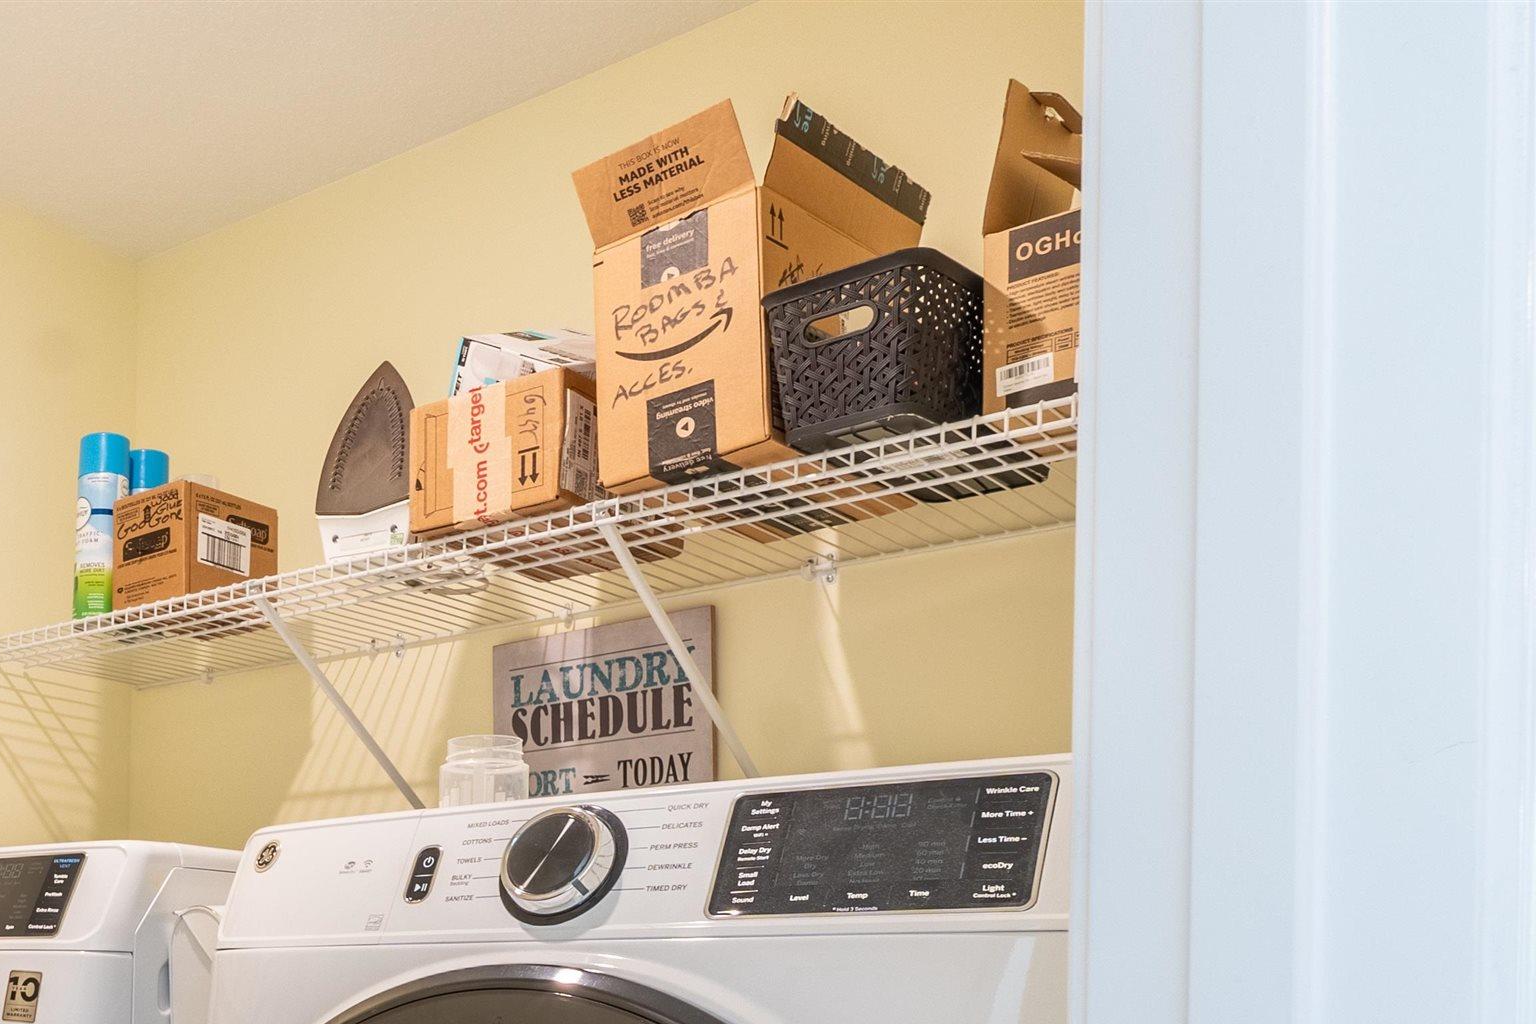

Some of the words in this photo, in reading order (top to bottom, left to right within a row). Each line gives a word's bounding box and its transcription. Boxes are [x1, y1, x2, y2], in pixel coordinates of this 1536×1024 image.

[618, 158, 636, 170] THIS
[636, 152, 652, 164] BOX
[654, 146, 661, 154] IS
[662, 138, 680, 150] NOW
[618, 162, 655, 186] MADE
[656, 146, 690, 168] WITH
[613, 184, 644, 202] LESS
[644, 155, 705, 190] MATERIAL
[645, 239, 662, 253] free
[663, 229, 695, 246] delivery
[612, 256, 739, 341] ROOMBA
[635, 300, 706, 346] BAGS
[694, 396, 714, 410] video
[656, 402, 693, 420] streaming
[512, 683, 694, 748] SCHEDULE
[618, 752, 693, 788] TODAY
[986, 786, 1018, 794] Wrinkle
[1019, 785, 1040, 793] Care
[668, 804, 692, 812] QUICK
[693, 802, 710, 810] DRY
[750, 808, 780, 816] Settings
[488, 819, 510, 827] LOADS
[662, 822, 703, 830] DELICATES
[762, 822, 780, 830] Alert
[462, 838, 492, 846] COTTONS
[978, 836, 998, 844] Less
[650, 844, 672, 852] PERM
[673, 842, 698, 850] PRESS
[738, 848, 758, 856] Delay
[759, 847, 772, 856] Dry
[647, 862, 692, 871] DEWRINKLE
[982, 862, 1014, 870] ecoDry
[671, 884, 688, 892] DRY
[982, 884, 1005, 892] Light
[445, 894, 474, 902] SANITIZE
[790, 894, 810, 902] Level
[846, 892, 868, 900] Temp
[9, 976, 40, 1002] 10
